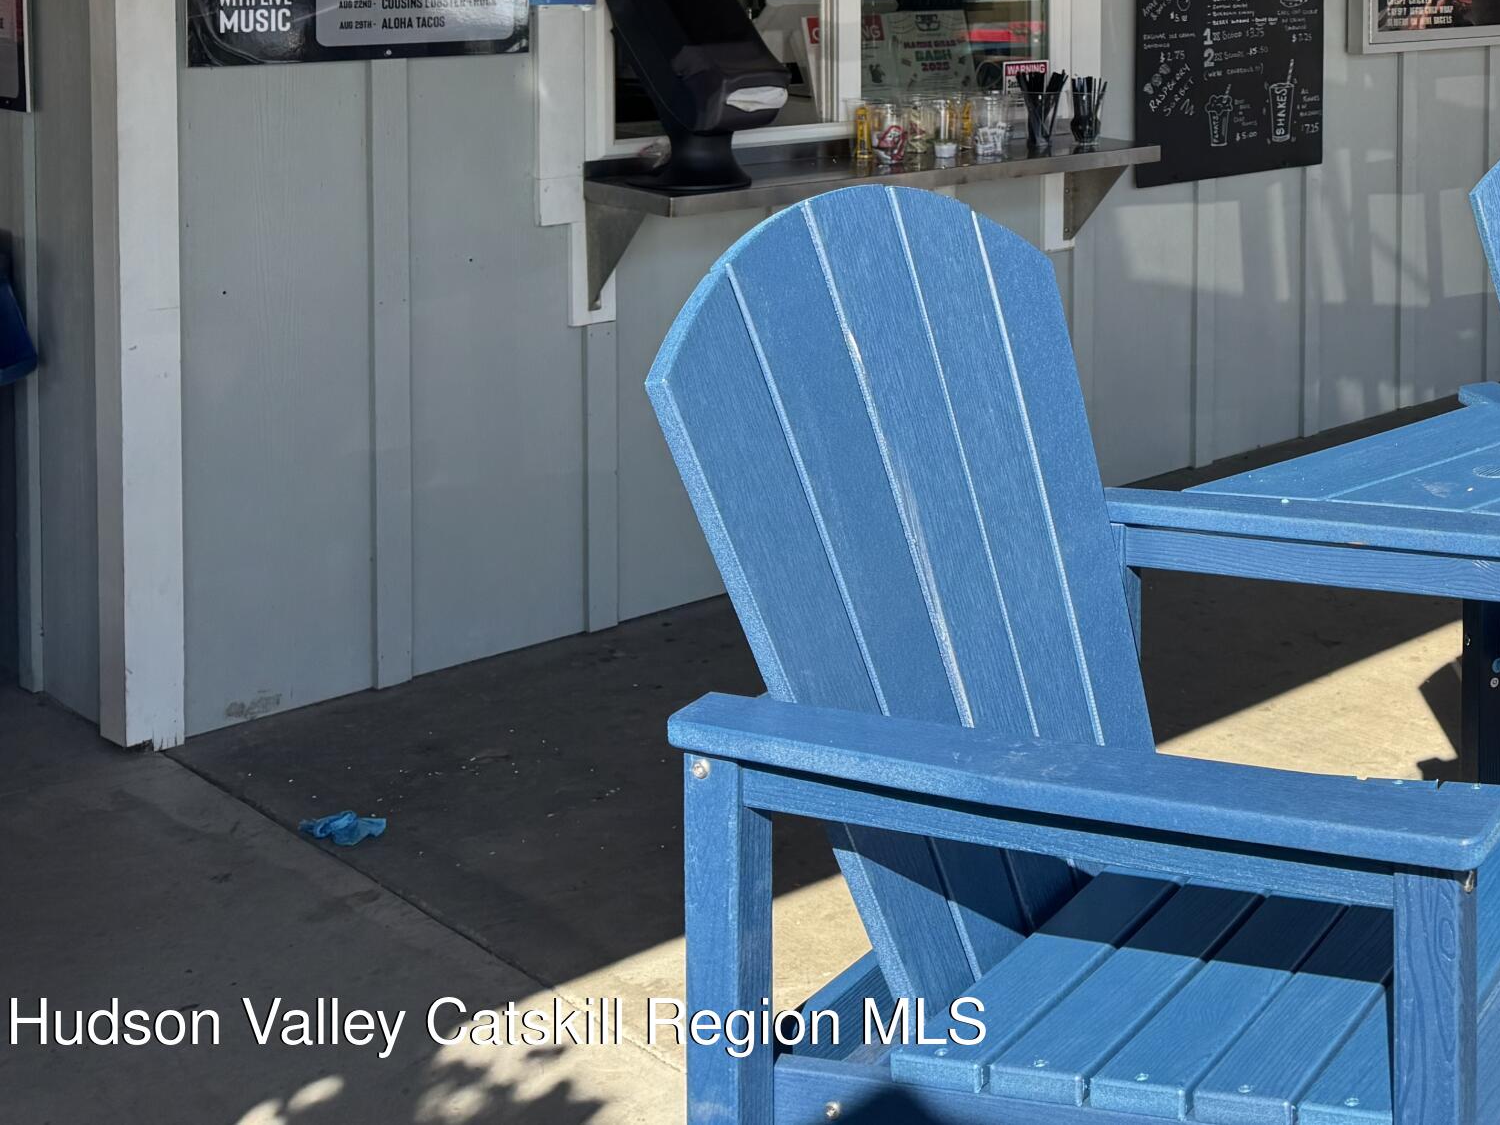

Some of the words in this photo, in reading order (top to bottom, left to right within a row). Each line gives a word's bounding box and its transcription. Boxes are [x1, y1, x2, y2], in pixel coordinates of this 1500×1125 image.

[339, 1, 353, 9] AUG
[219, 8, 291, 34] MUSIC
[339, 21, 353, 30] AUG
[382, 17, 413, 29] ALOHA
[416, 16, 445, 28] TACOS
[1204, 48, 1215, 67] 2
[1006, 64, 1046, 75] WARNING
